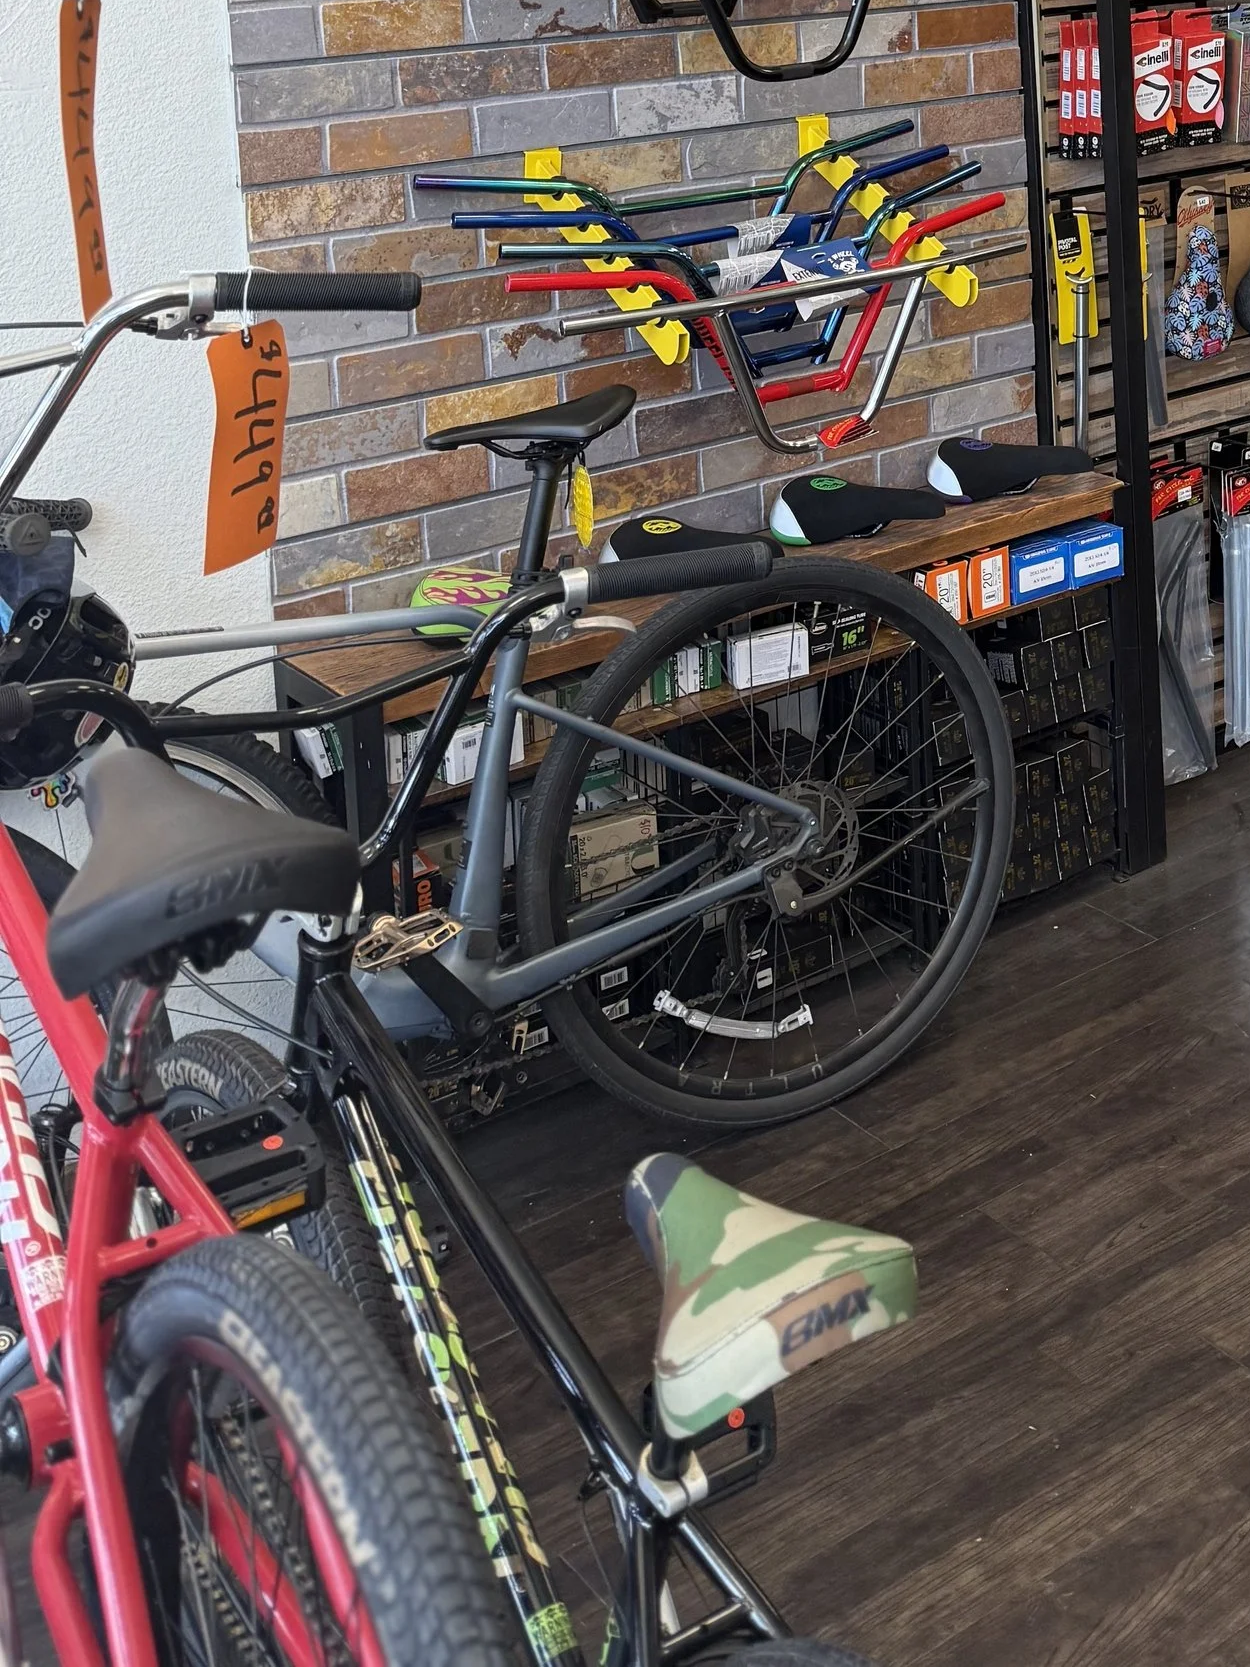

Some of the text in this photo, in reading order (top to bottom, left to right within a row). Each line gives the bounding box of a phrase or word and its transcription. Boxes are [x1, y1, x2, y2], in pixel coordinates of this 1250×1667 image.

[842, 625, 865, 646] 16"
[418, 880, 433, 913] URO
[157, 1056, 223, 1101] EASTERN
[782, 1284, 876, 1358] BMX
